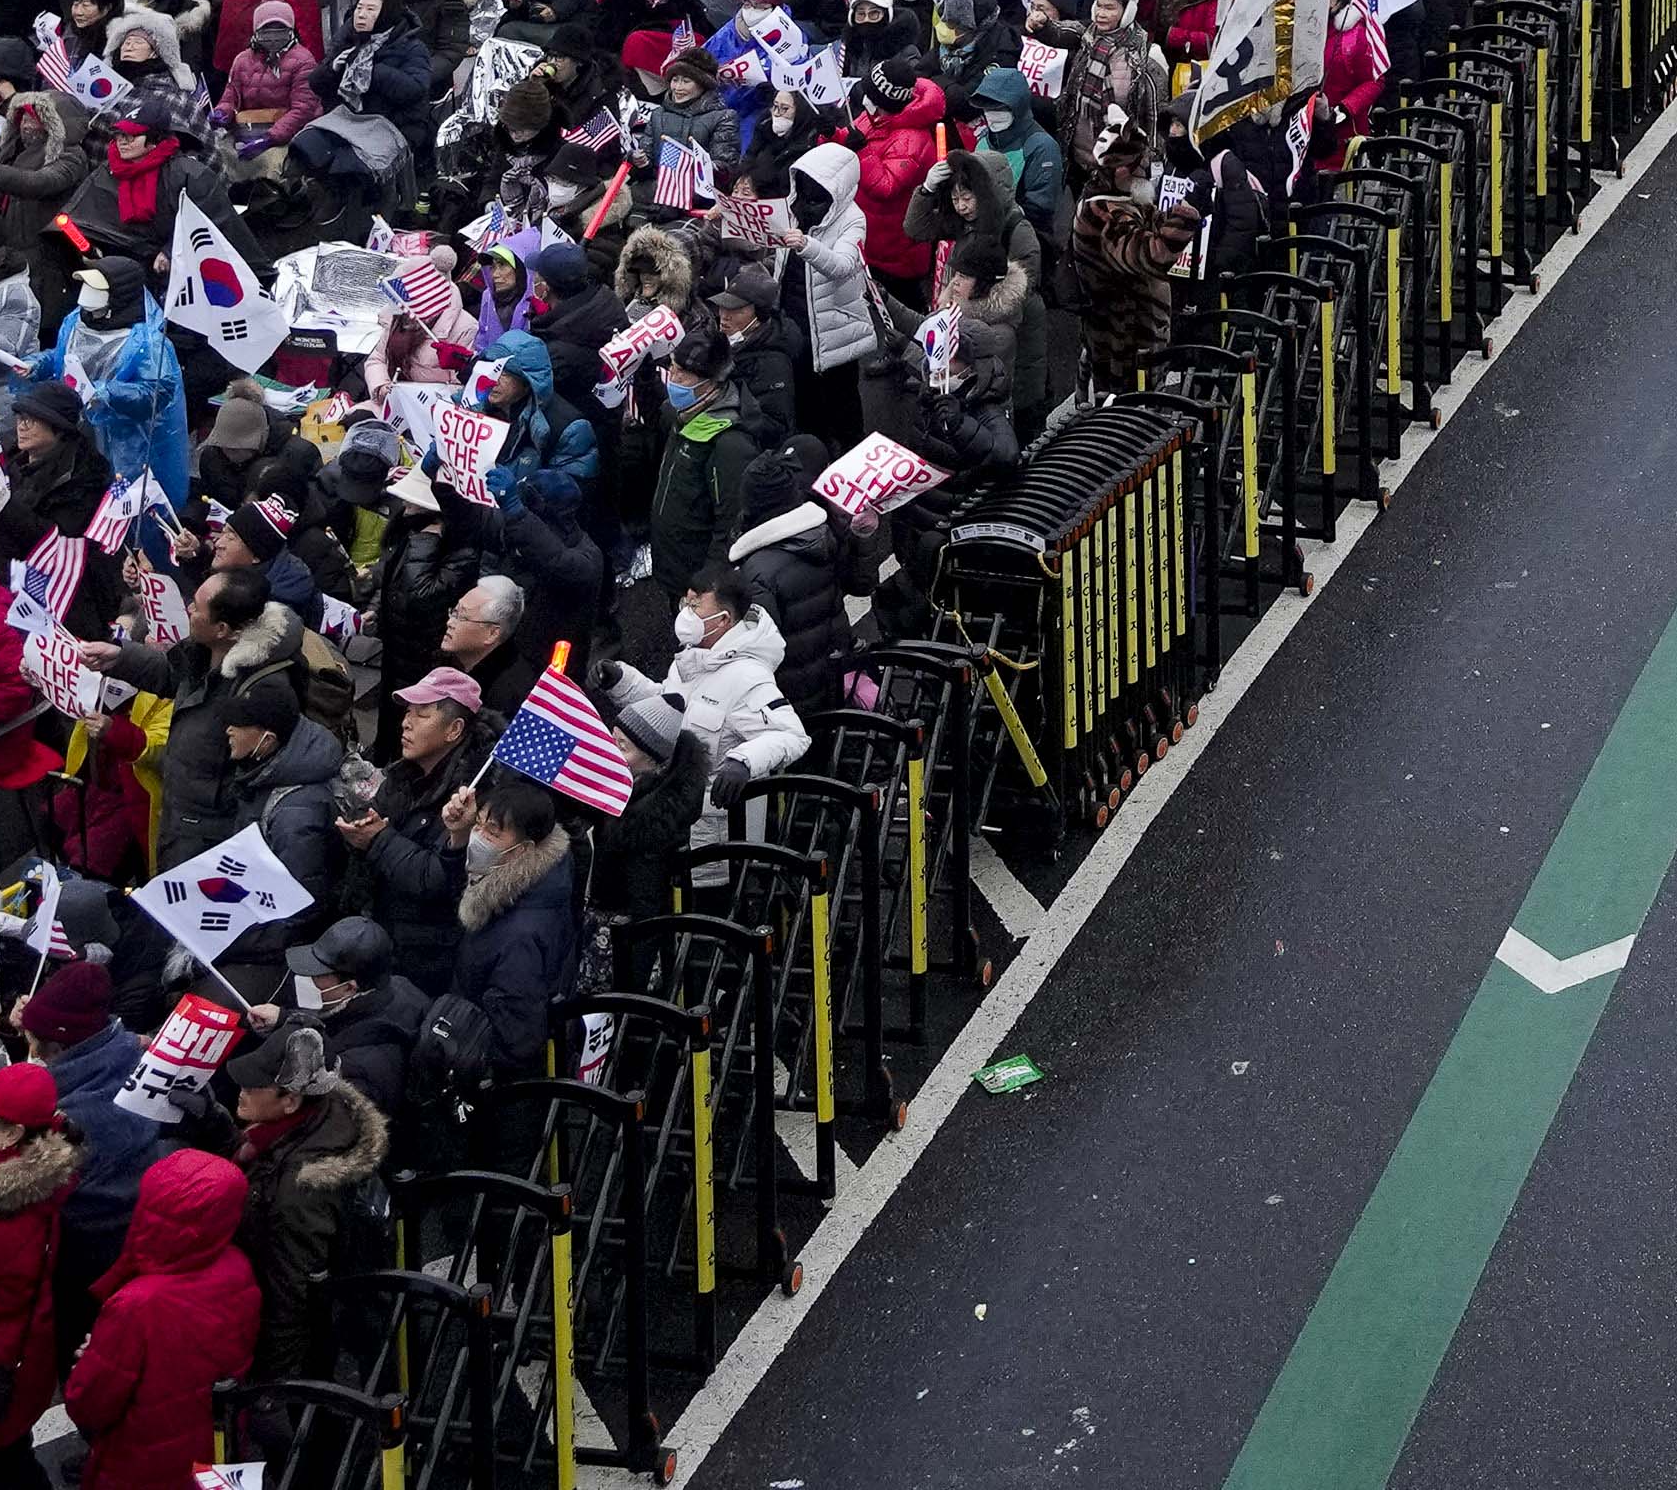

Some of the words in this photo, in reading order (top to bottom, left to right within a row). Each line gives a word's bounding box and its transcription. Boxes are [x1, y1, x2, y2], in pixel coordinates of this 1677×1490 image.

[1021, 41, 1058, 62] TOP
[720, 62, 749, 80] OP
[735, 212, 772, 234] THE
[644, 309, 678, 341] OP
[439, 408, 493, 445] STOP
[442, 437, 479, 468] THE
[869, 430, 932, 484] STOP
[139, 572, 165, 600] OP
[142, 599, 167, 623] HE
[39, 659, 81, 692] THE
[155, 1006, 231, 1062] 반대
